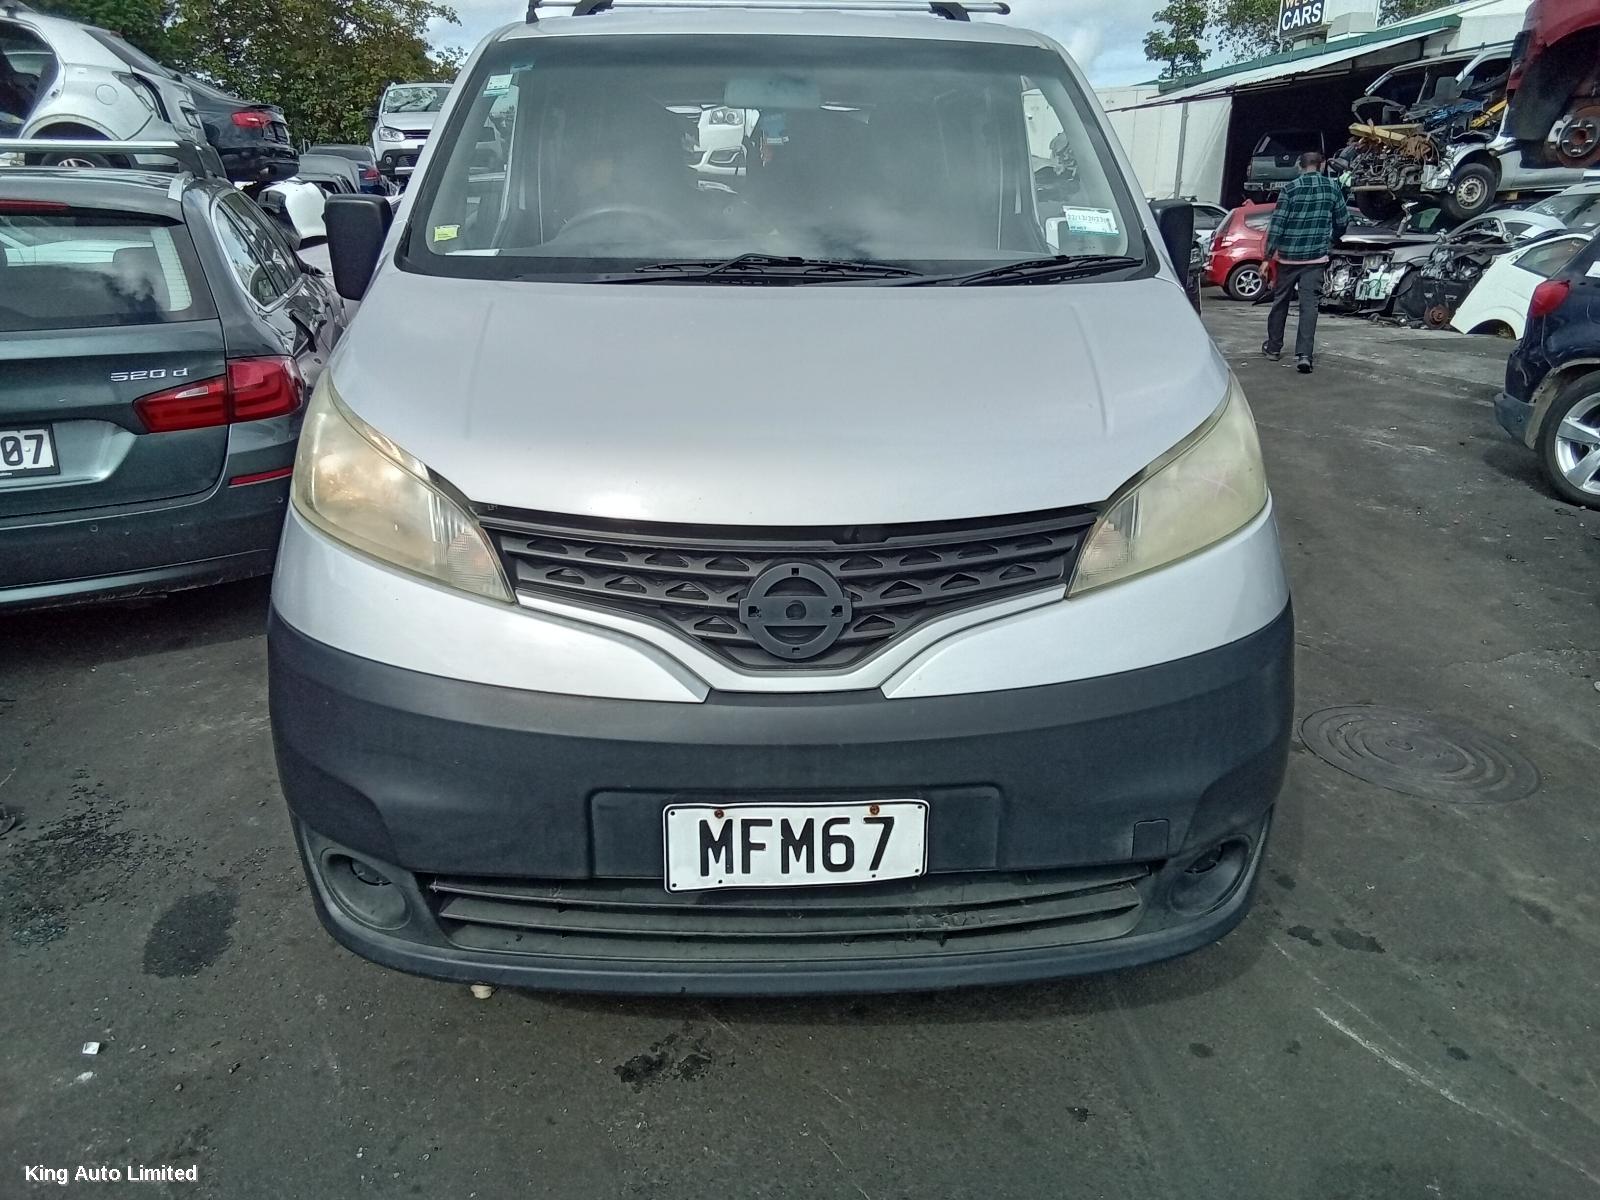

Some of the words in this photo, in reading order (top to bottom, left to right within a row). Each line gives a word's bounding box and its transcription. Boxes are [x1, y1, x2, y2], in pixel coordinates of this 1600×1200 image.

[1281, 2, 1322, 31] CARS
[0, 434, 44, 466] 07
[699, 816, 895, 877] MFM67
